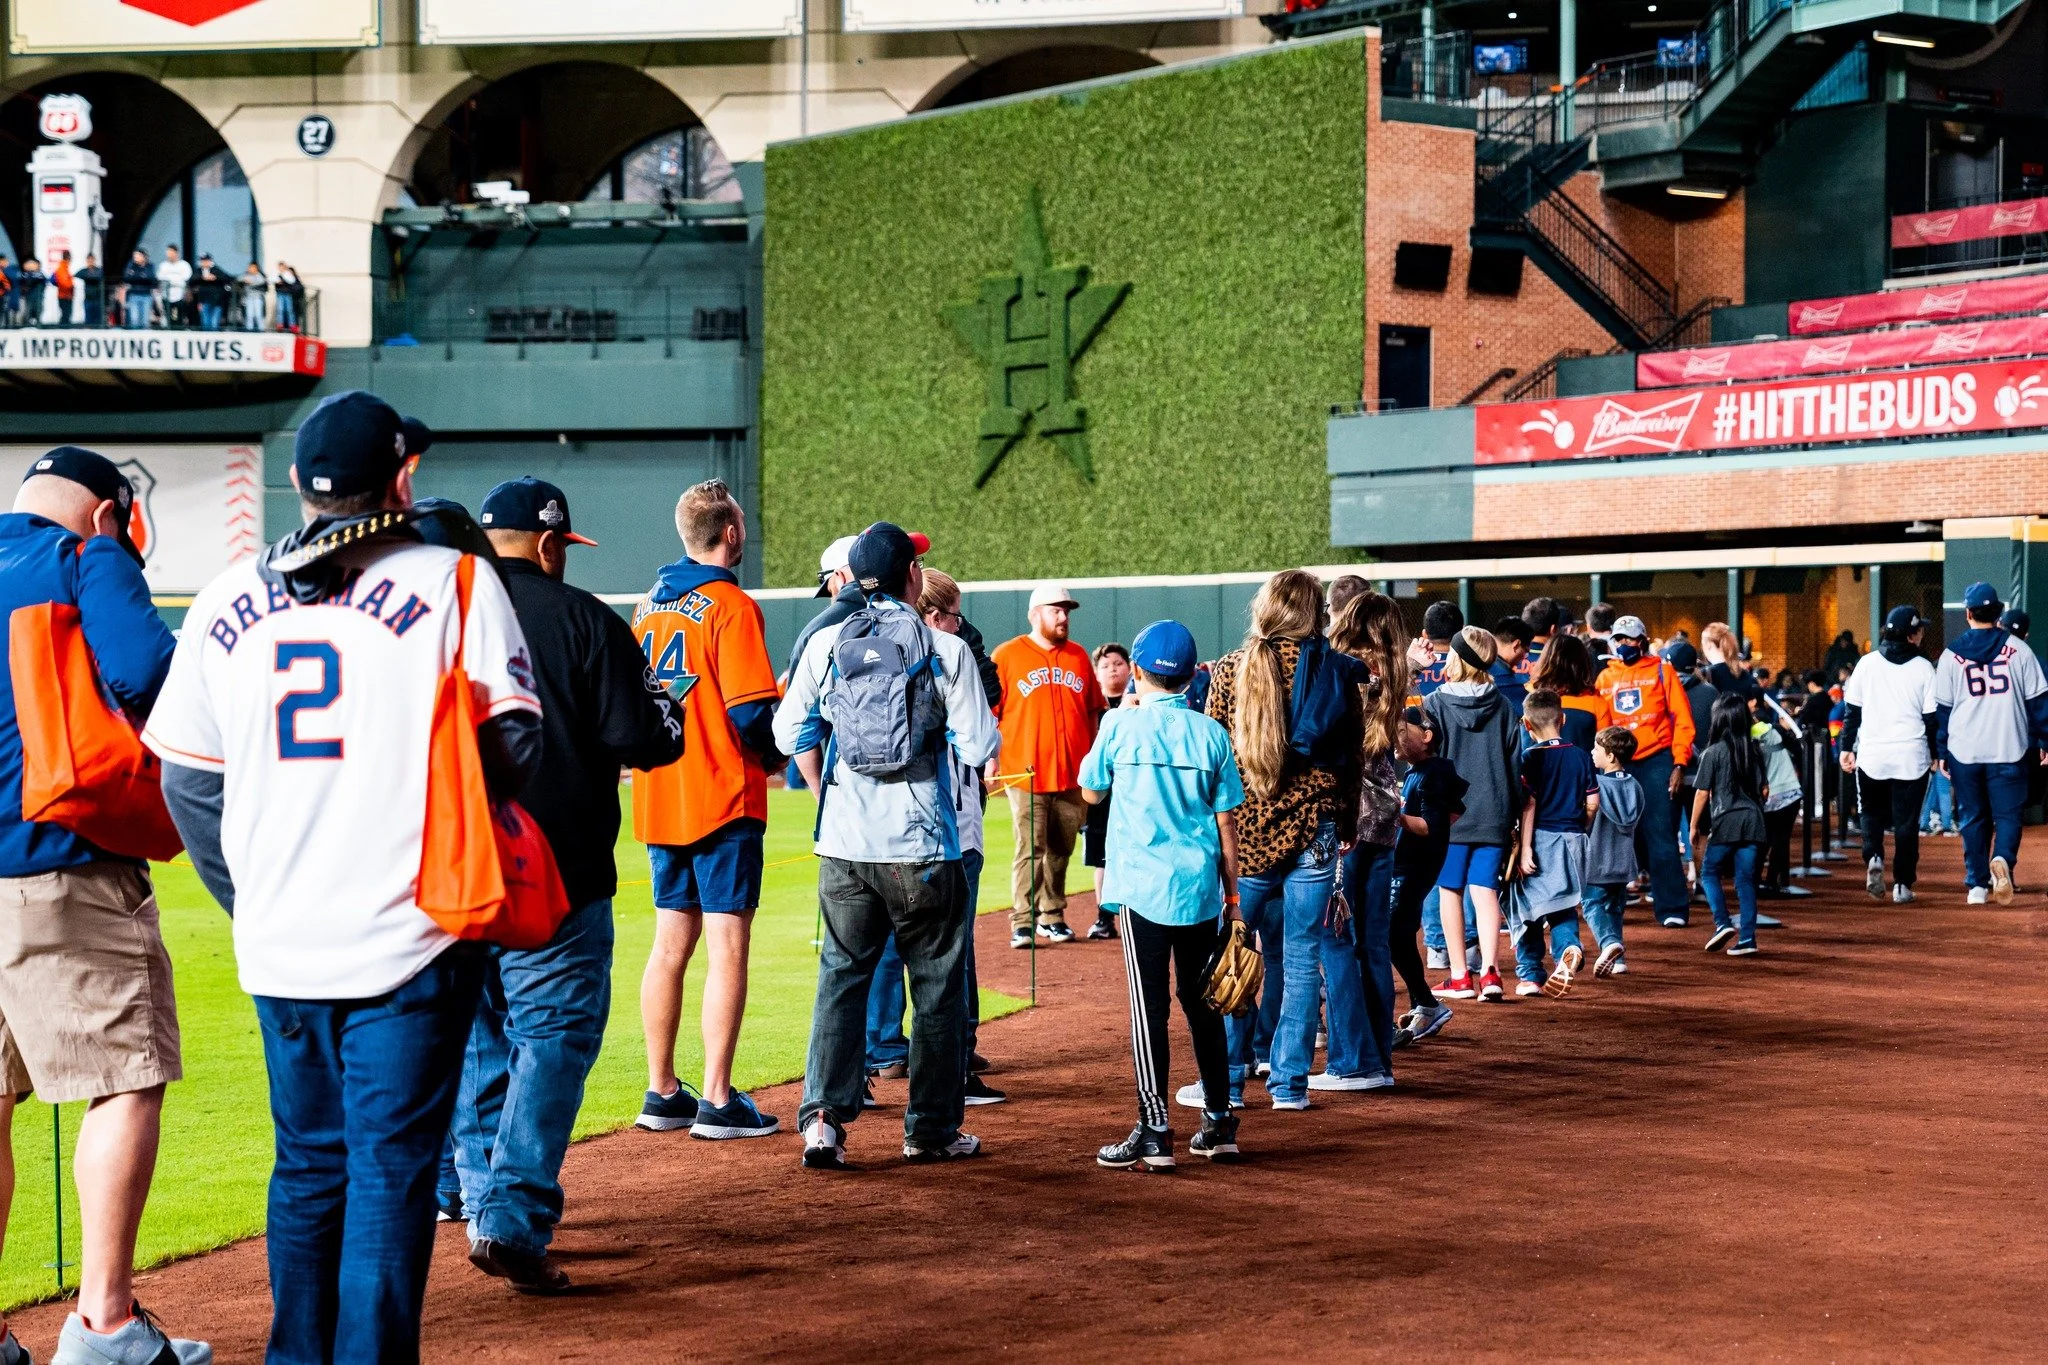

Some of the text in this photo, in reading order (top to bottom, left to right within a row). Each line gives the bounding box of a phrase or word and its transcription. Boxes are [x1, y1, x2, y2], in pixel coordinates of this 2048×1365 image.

[302, 120, 330, 144] 27
[22, 338, 162, 359] IMPROVING
[173, 340, 252, 361] LIVES.
[1713, 372, 1978, 442] #HITTHEBUDS
[1594, 410, 1691, 438] Budweiser
[1017, 667, 1084, 697] ASTROS
[1965, 660, 2010, 697] 65
[275, 640, 344, 761] 2
